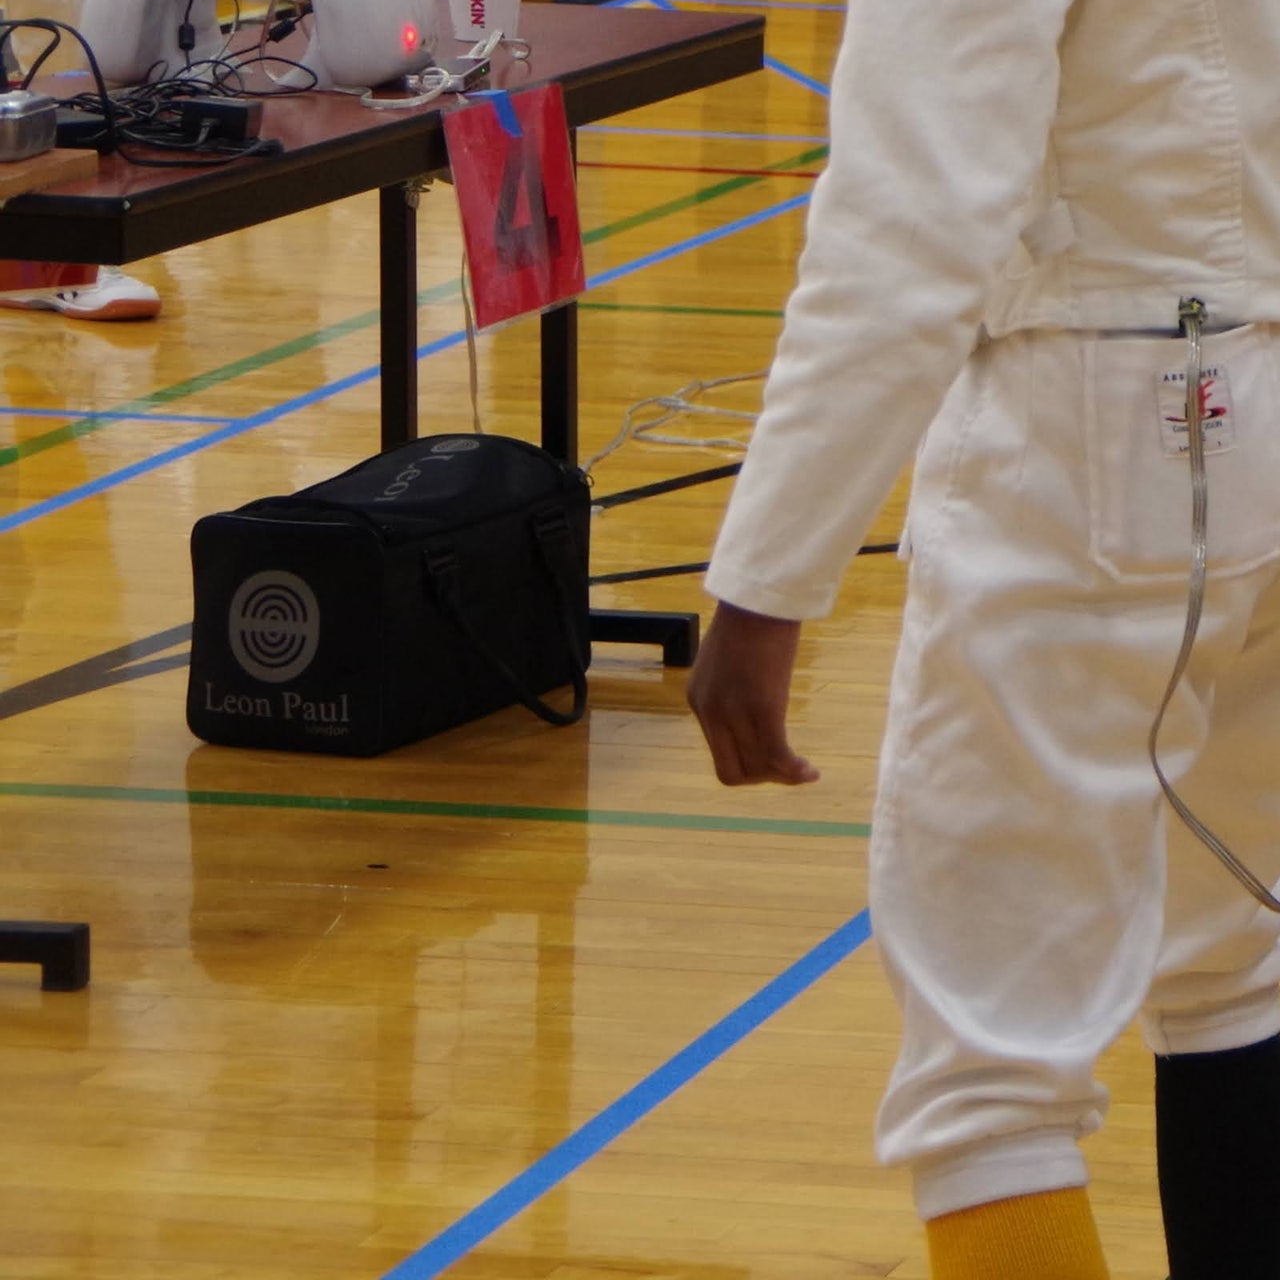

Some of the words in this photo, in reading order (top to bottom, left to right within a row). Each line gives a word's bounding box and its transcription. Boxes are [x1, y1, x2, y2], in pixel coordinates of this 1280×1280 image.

[494, 135, 562, 290] 4
[204, 680, 273, 718] Leon
[281, 690, 351, 723] Paul
